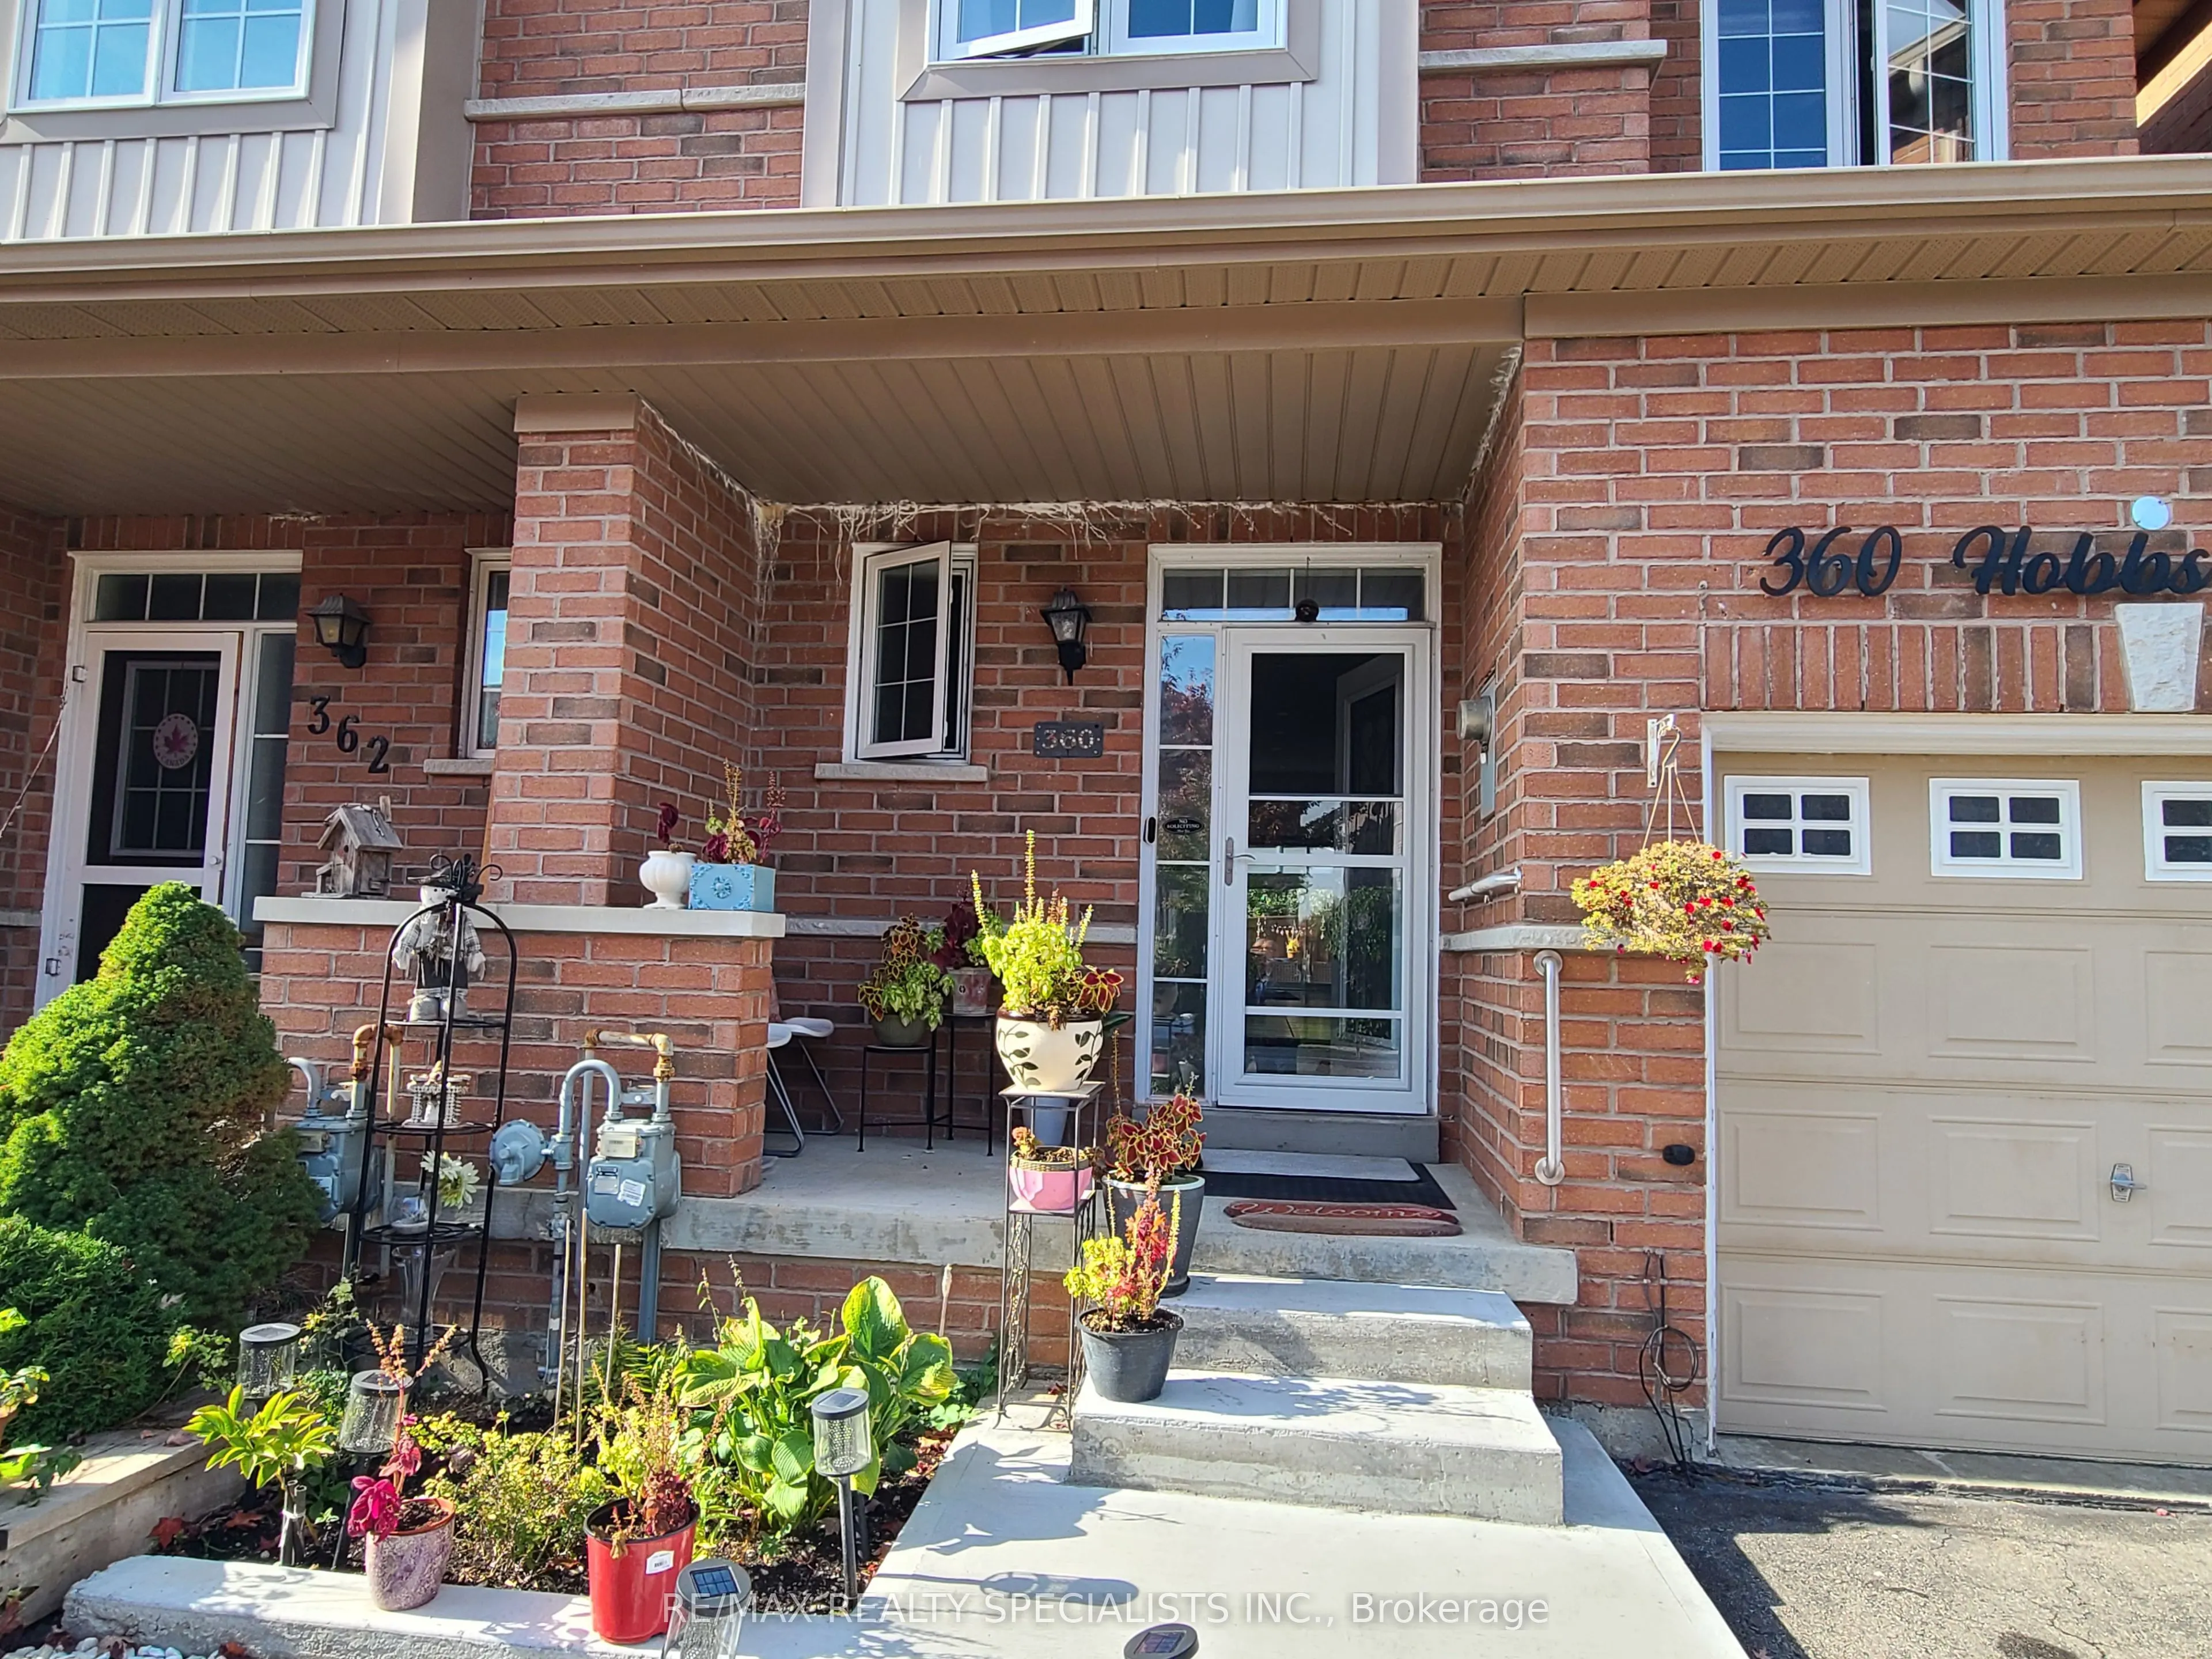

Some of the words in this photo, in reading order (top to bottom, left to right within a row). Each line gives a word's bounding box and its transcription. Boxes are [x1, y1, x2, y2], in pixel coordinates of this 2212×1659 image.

[1760, 525, 1903, 597] 360
[1949, 525, 2212, 596] Hobbs
[307, 695, 389, 774] 362
[1041, 728, 1094, 749] 360
